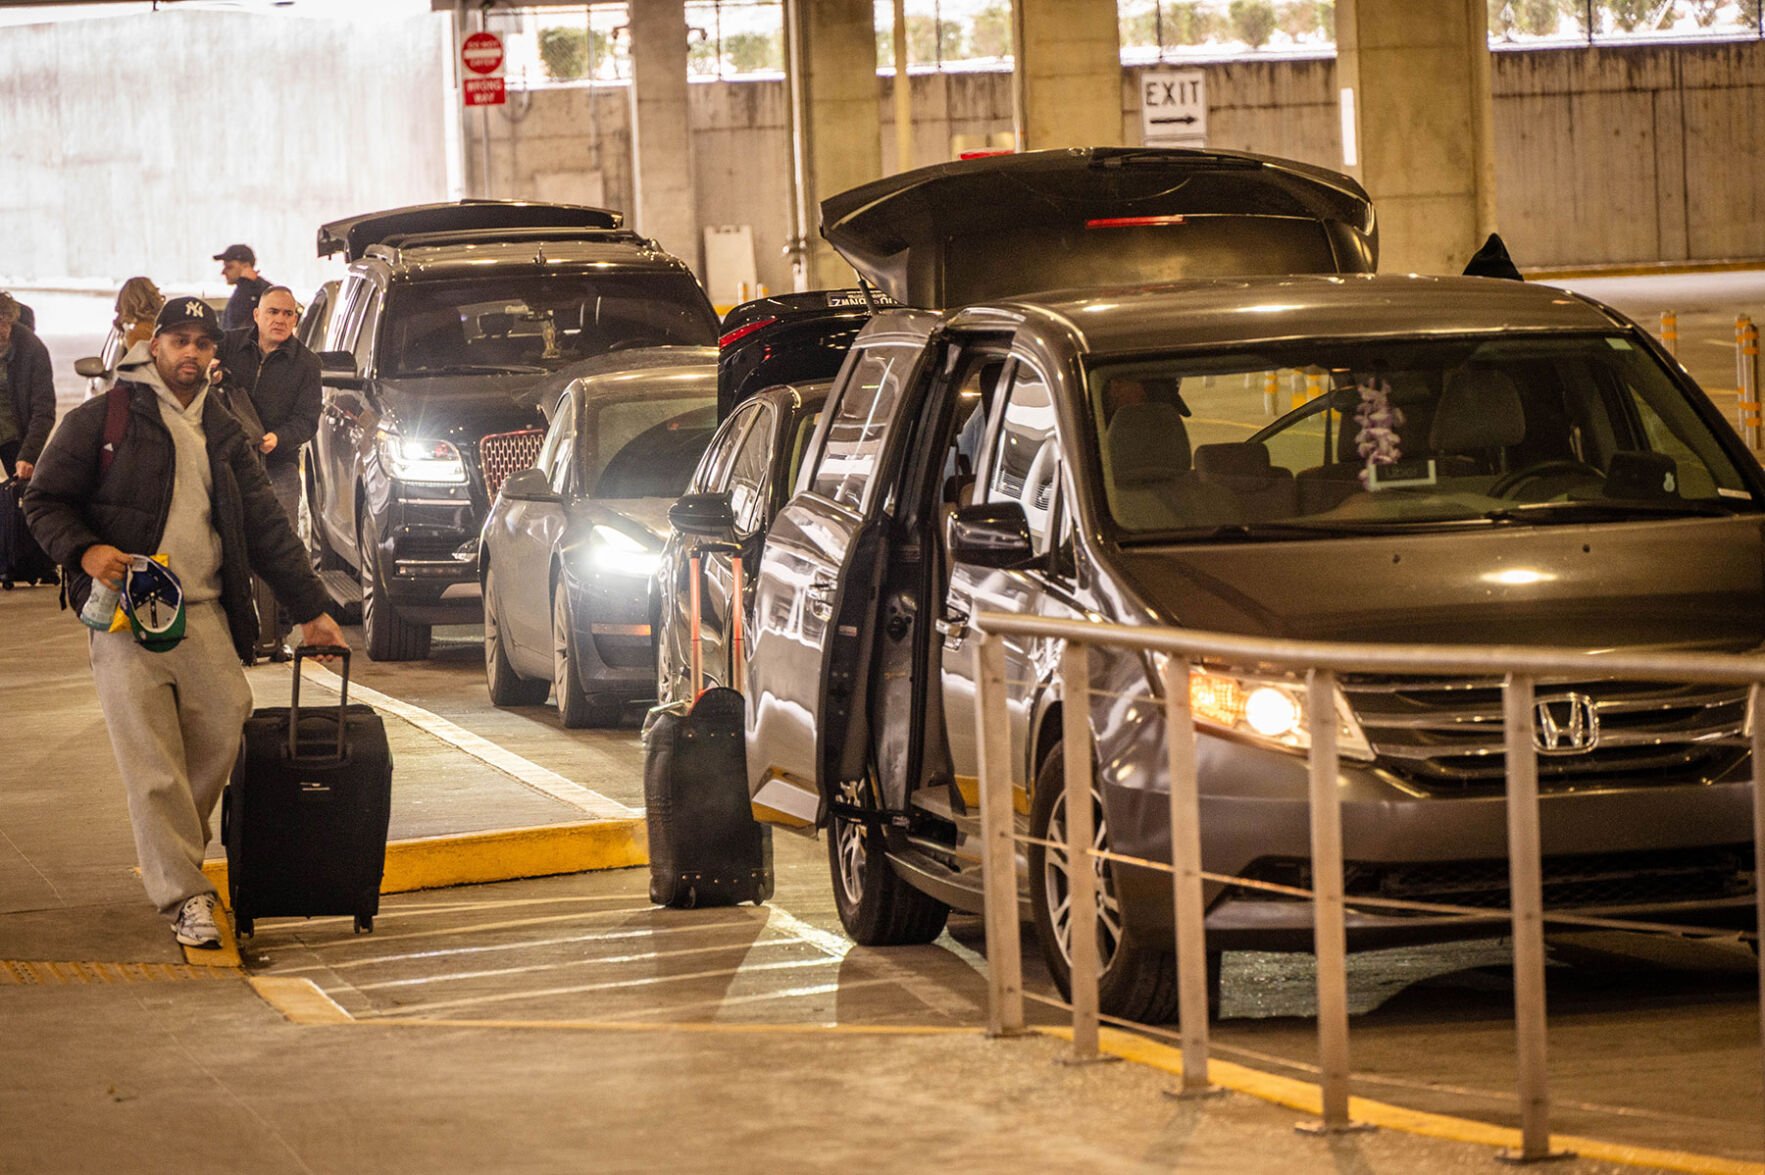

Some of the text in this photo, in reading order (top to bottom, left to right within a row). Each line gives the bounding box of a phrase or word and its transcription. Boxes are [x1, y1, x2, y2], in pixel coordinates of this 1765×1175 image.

[467, 80, 502, 92] WRONG
[473, 92, 495, 104] WAY
[1146, 81, 1199, 106] EXIT
